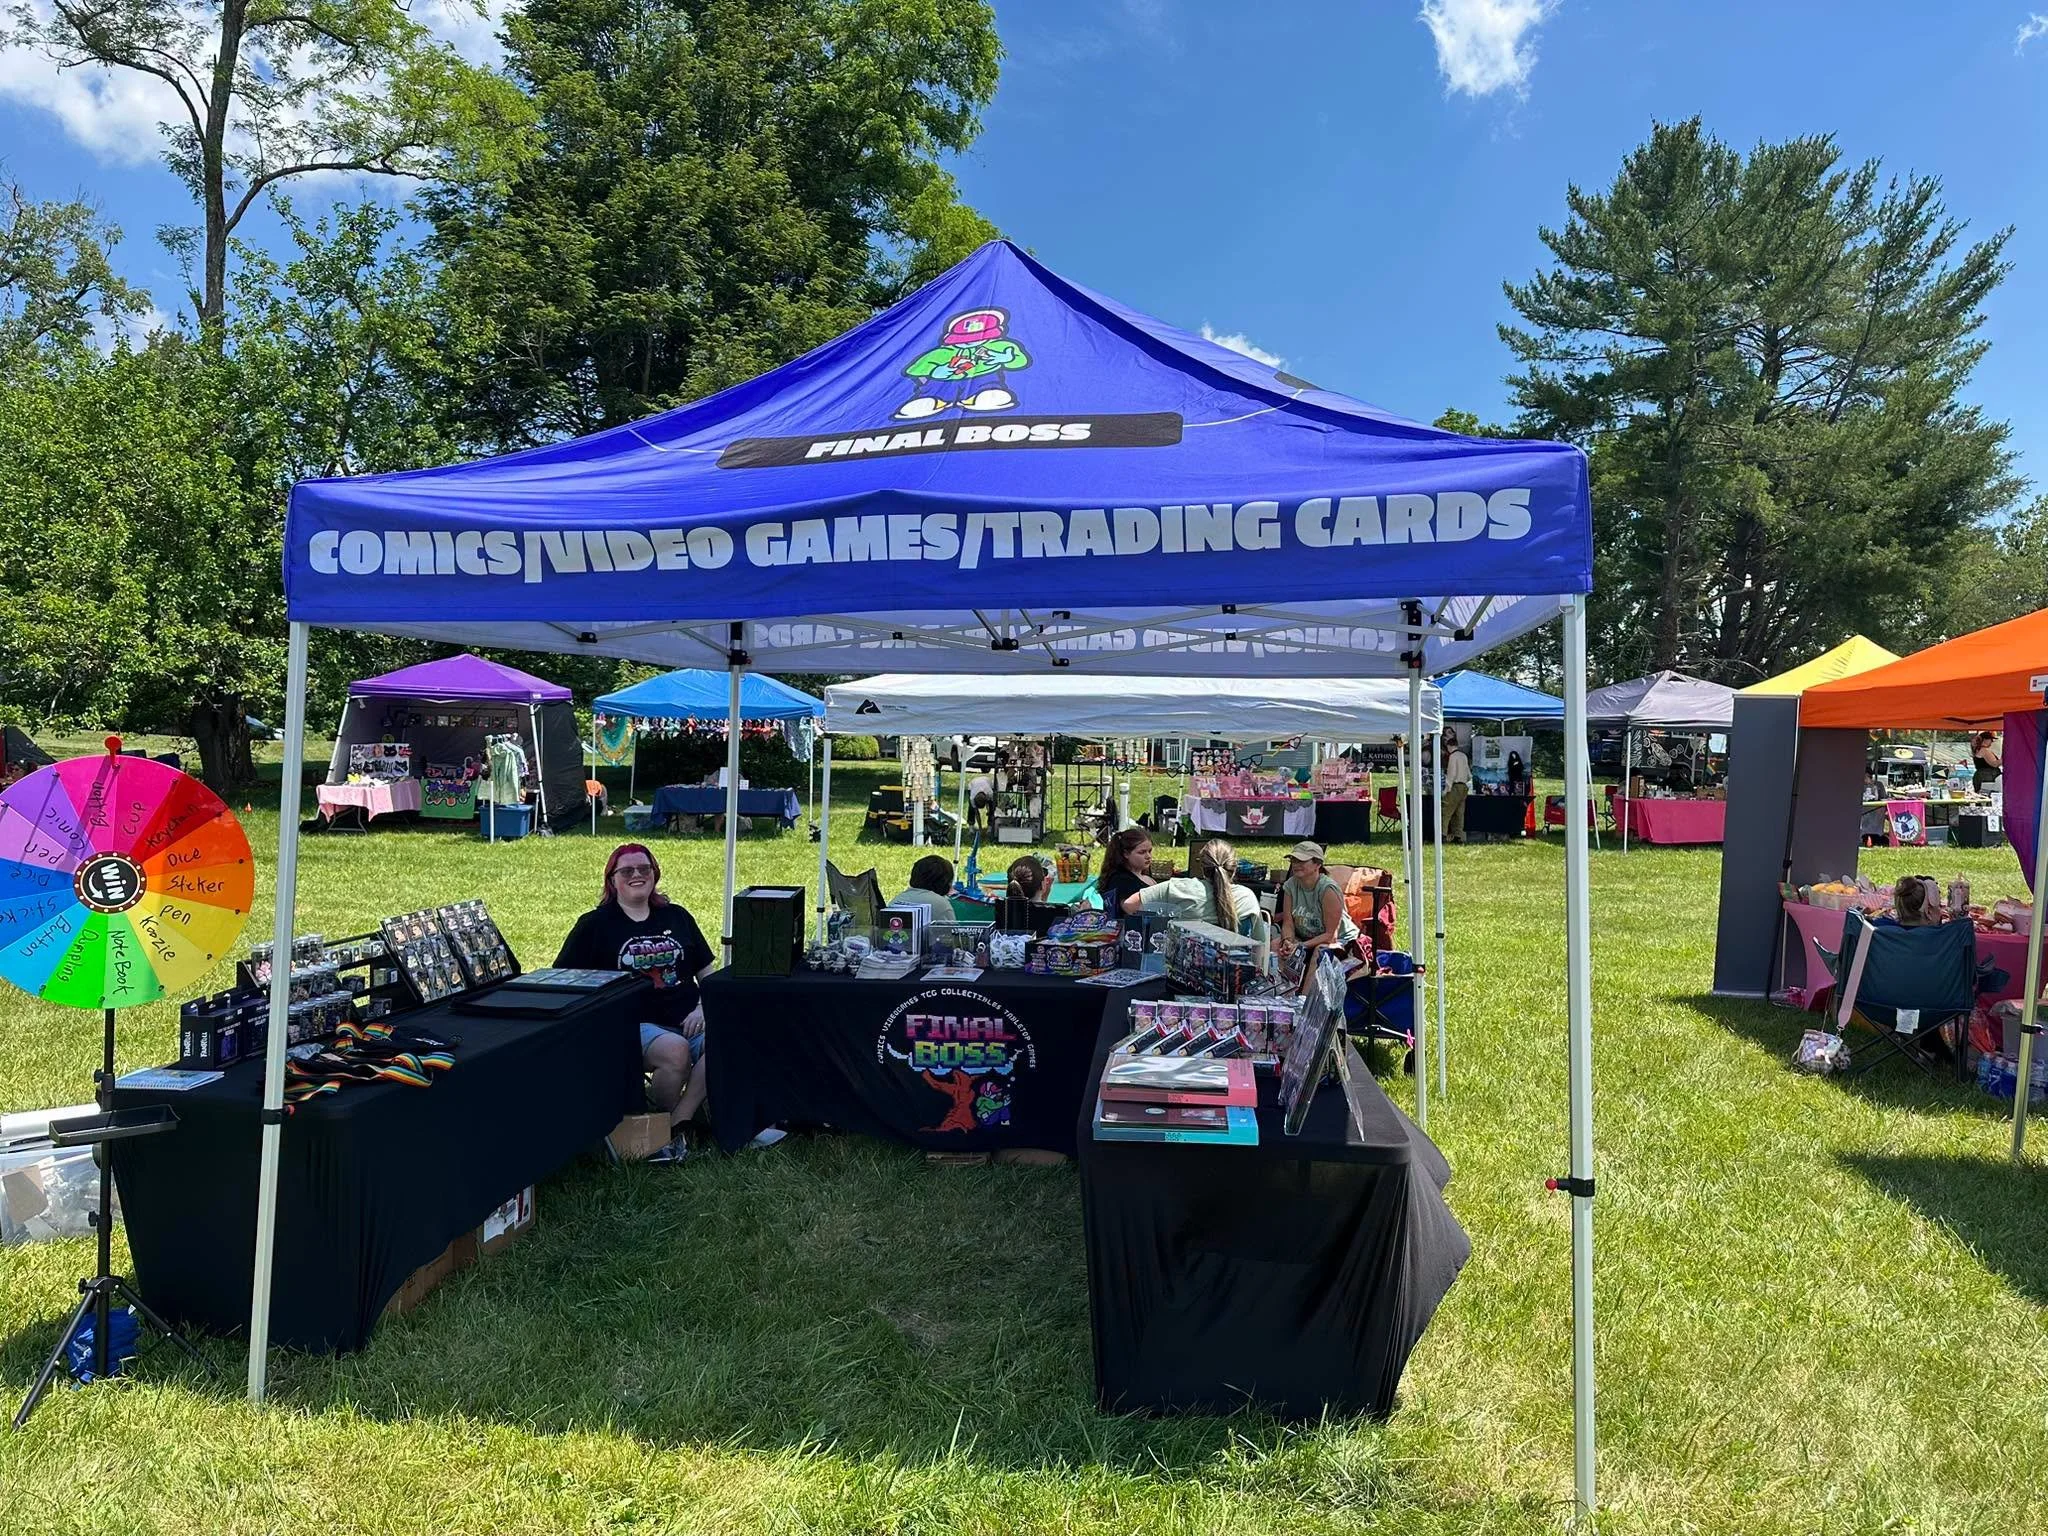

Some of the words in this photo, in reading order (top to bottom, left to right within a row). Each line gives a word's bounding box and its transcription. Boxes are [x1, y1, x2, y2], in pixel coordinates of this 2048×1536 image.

[804, 428, 947, 459] FINAL
[954, 422, 1092, 443] BOSS
[308, 525, 734, 584] COMICS/VIDEO
[745, 500, 1281, 570] GAMES/TRADING
[1294, 487, 1533, 548] CARDS
[90, 781, 110, 828] Button
[124, 802, 147, 835] Cup
[45, 807, 88, 851] Comic
[8, 863, 51, 888] Dice
[167, 848, 202, 868] Dice
[0, 895, 58, 923] Sticke
[19, 914, 73, 958] Button
[140, 915, 177, 962] Koozie
[629, 940, 675, 956] FINAL
[57, 927, 99, 984] Dumpling
[634, 951, 674, 967] BOSS
[882, 996, 919, 1032] VIDEOGAMES
[920, 989, 938, 999] TCG
[941, 988, 1002, 1011] COLLECTIBLES
[1003, 1009, 1031, 1042] TABLETOP
[1027, 1043, 1037, 1069] GAMES
[905, 1014, 1017, 1041] FINAL
[914, 1041, 1008, 1068] BOSS
